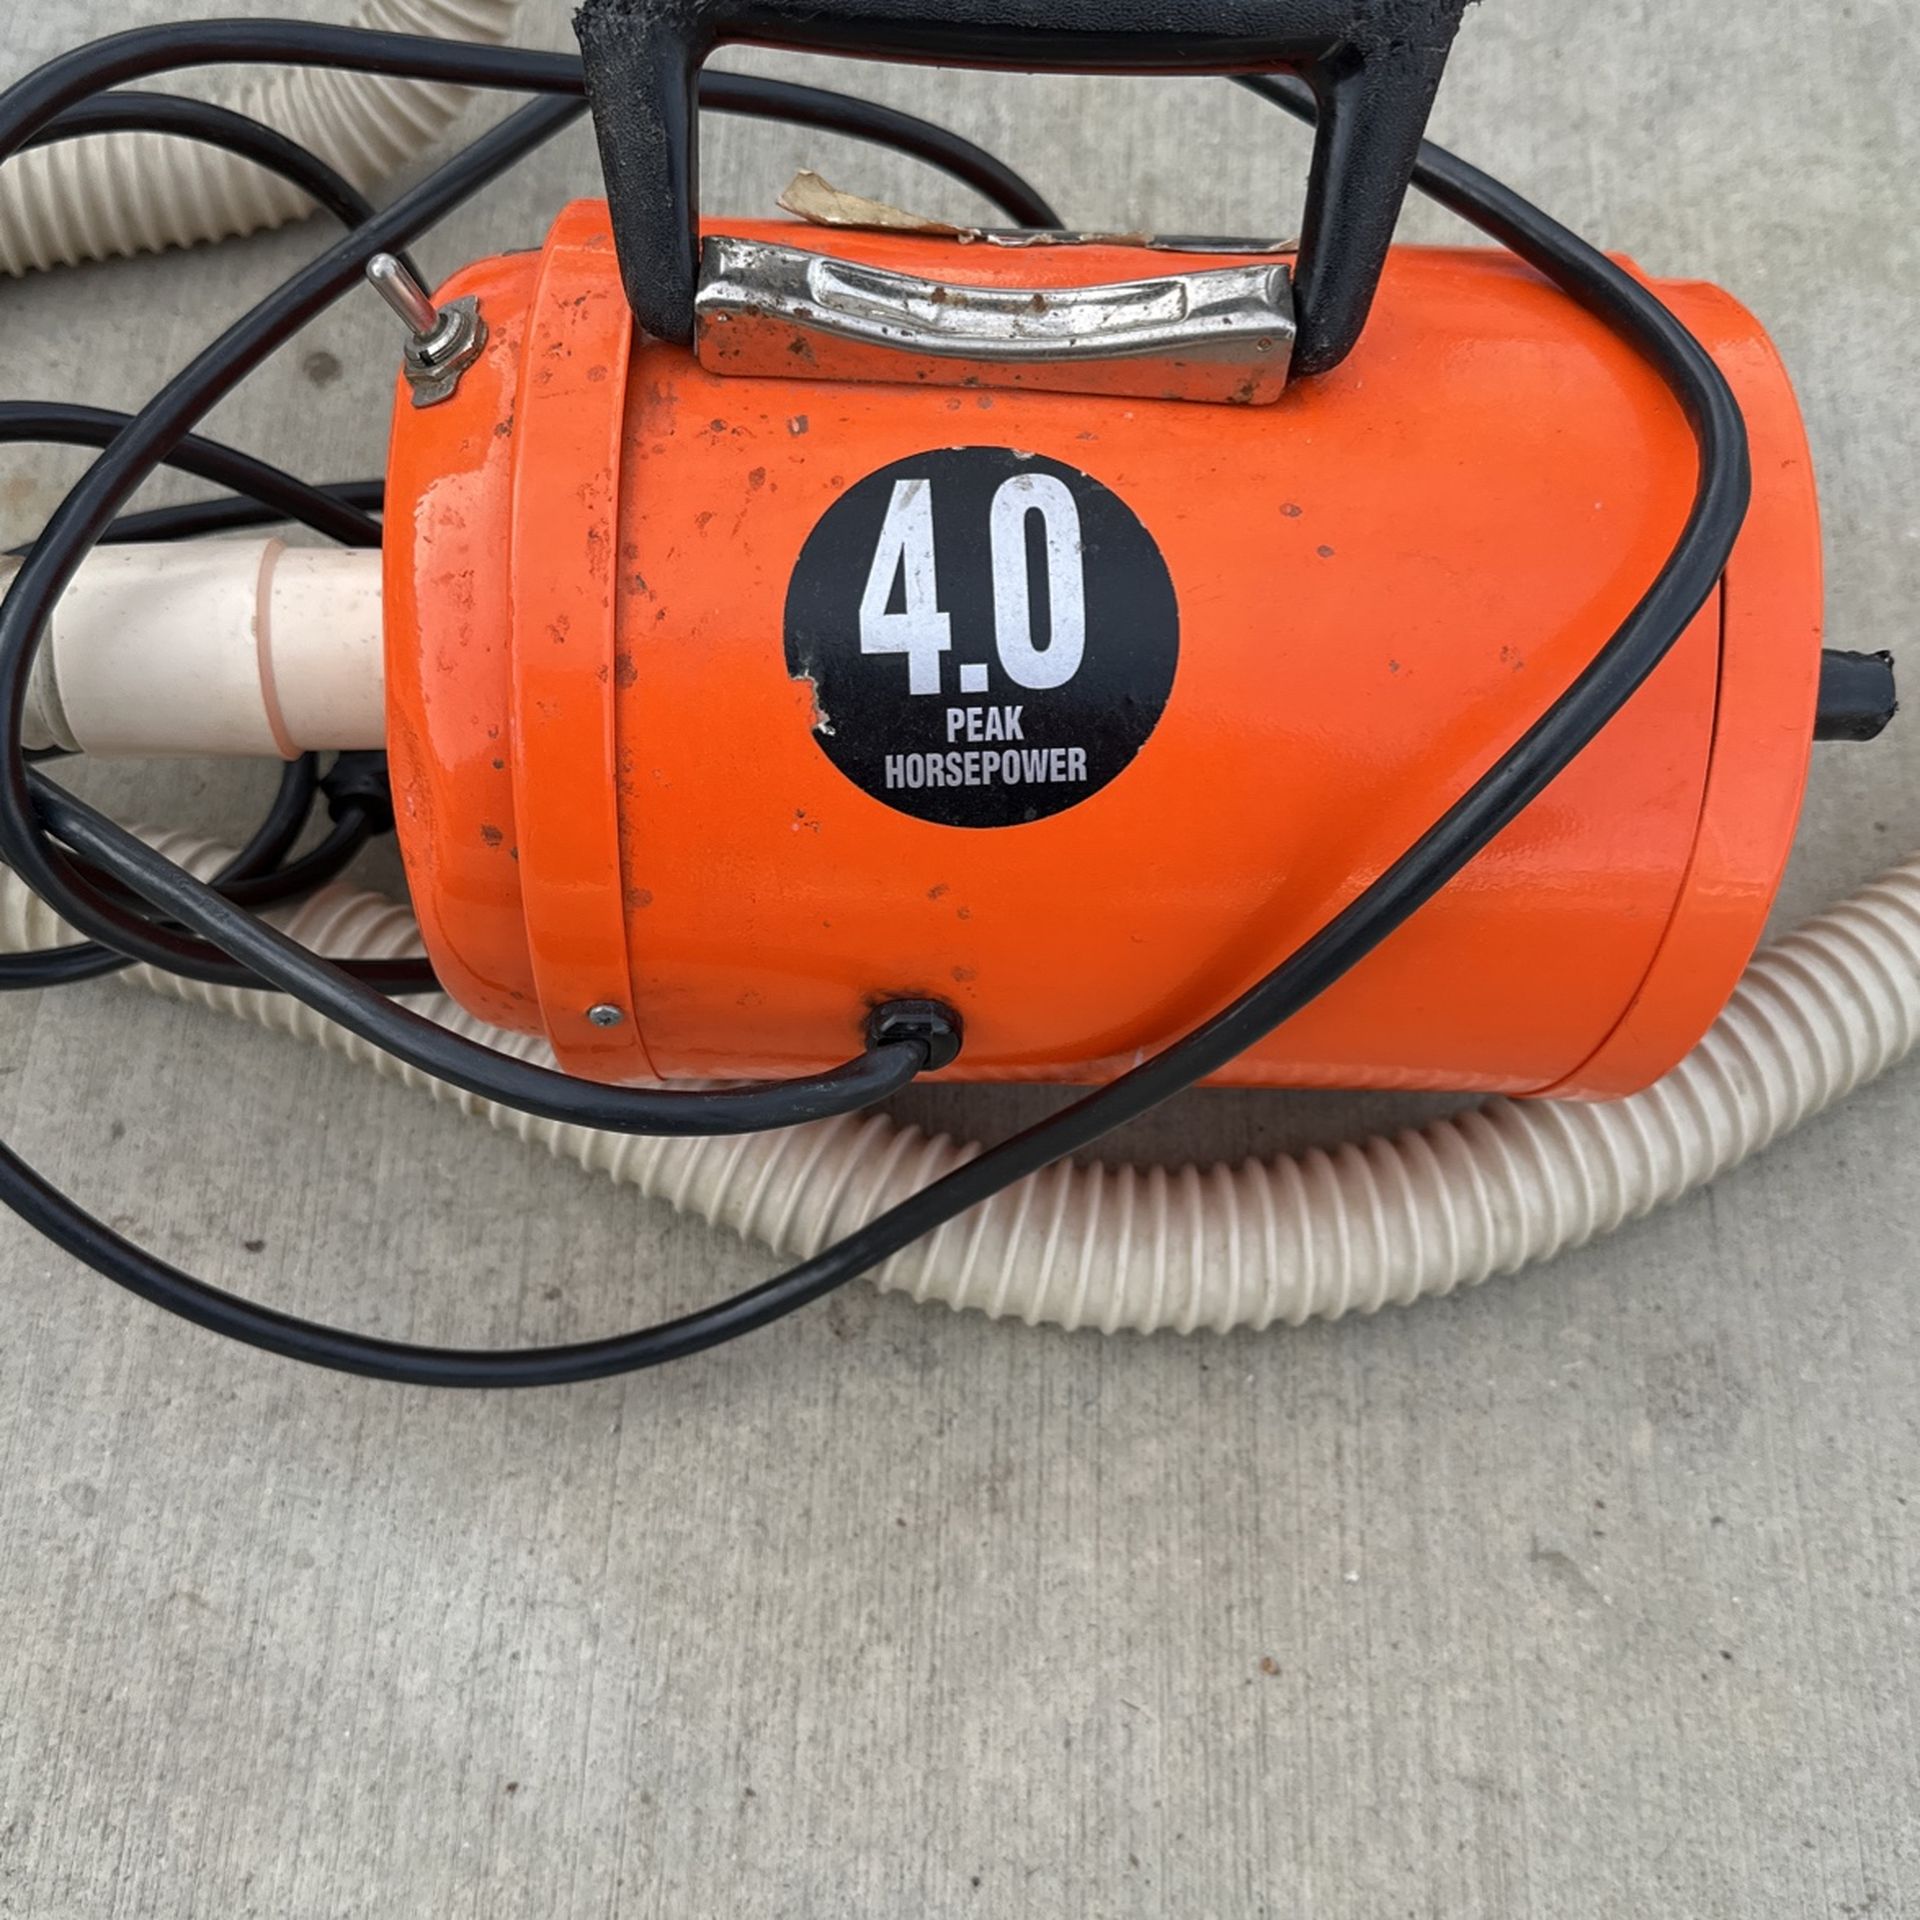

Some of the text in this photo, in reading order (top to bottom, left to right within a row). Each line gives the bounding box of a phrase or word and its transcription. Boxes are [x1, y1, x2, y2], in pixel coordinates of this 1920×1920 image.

[858, 472, 1086, 695] 4.0
[946, 705, 1024, 743] PEAK
[885, 747, 1087, 789] HORSEPOWER
